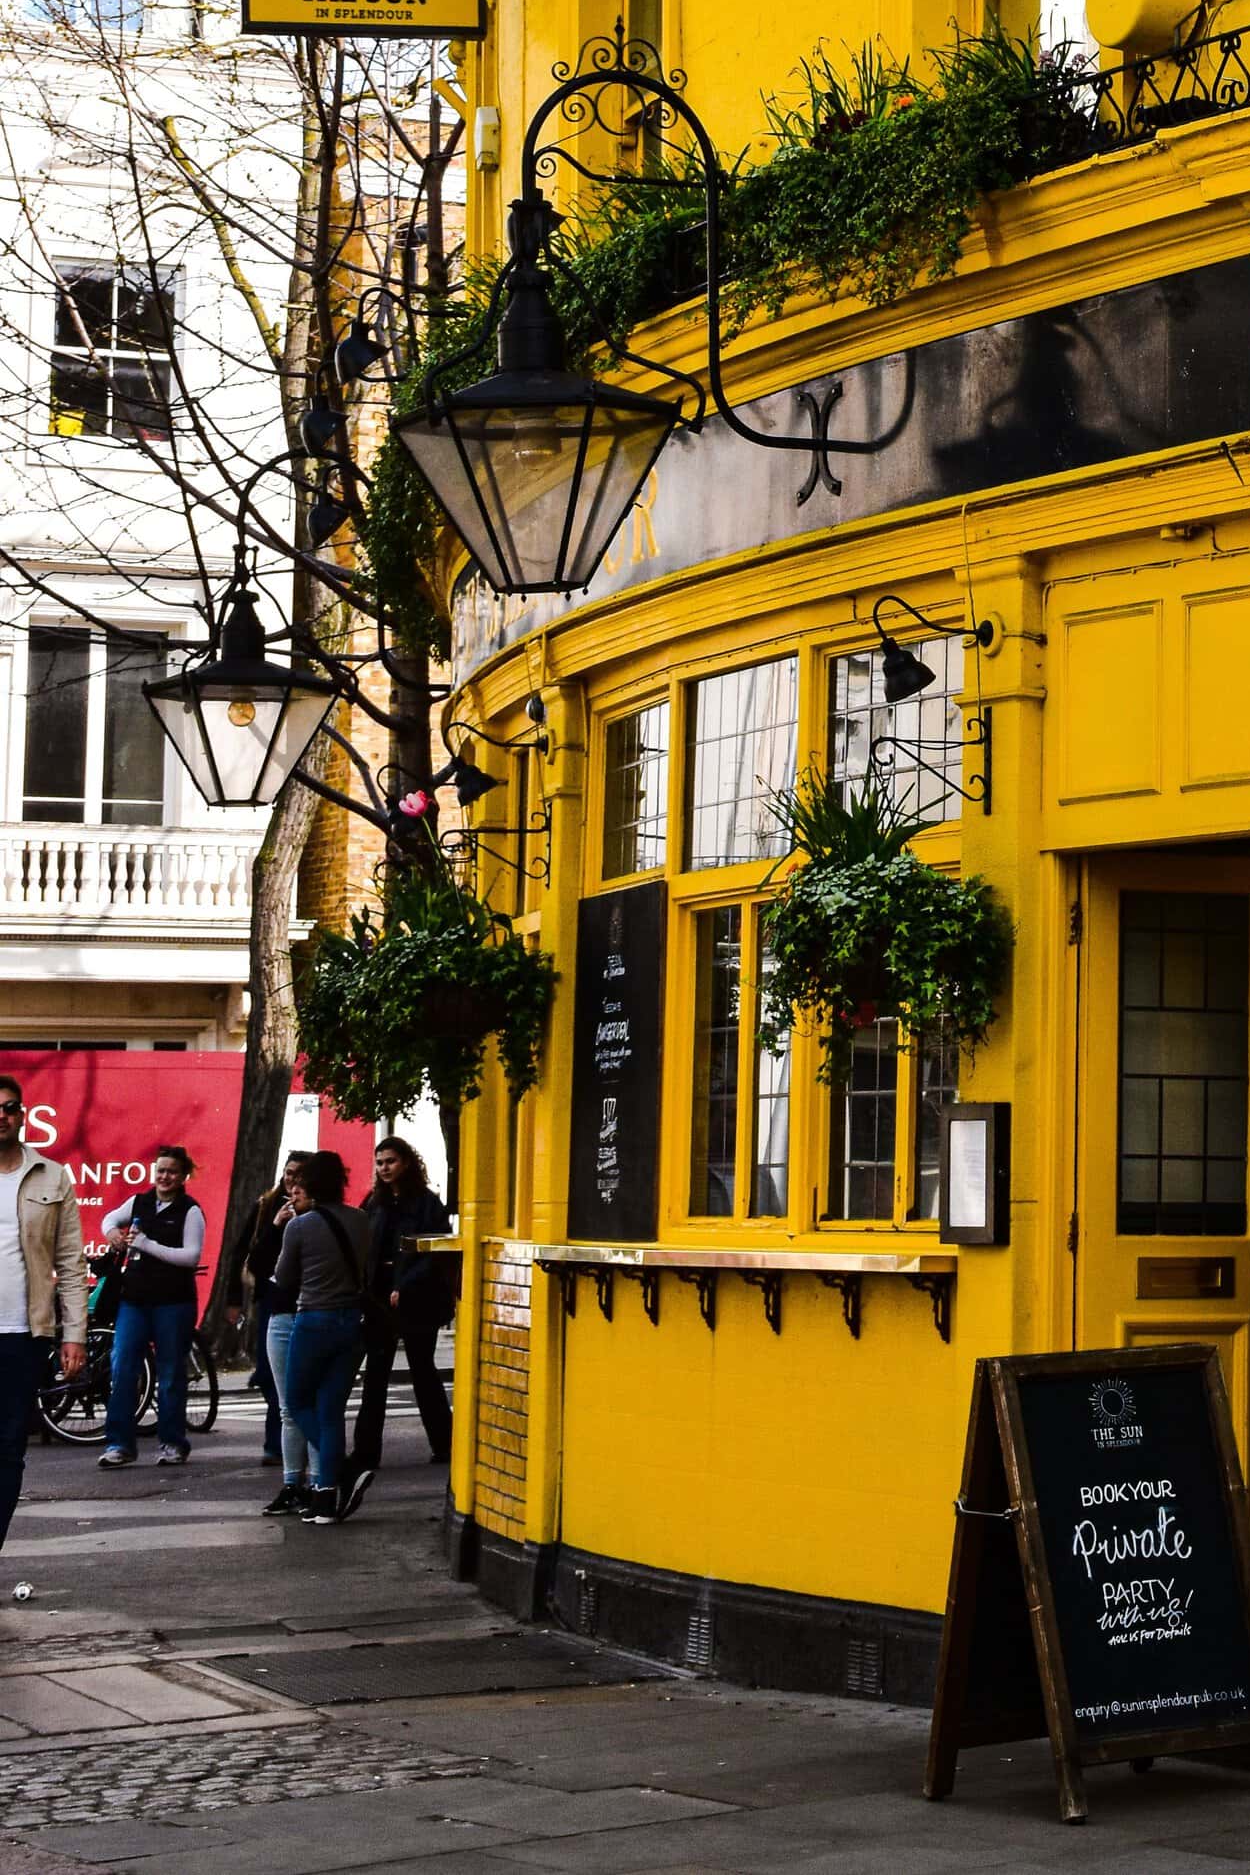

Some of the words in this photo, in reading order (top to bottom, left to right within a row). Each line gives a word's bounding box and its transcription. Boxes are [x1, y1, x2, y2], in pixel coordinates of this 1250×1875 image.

[315, 7, 329, 19] IN
[334, 8, 414, 21] SPLENDOUR
[1090, 1427, 1115, 1441] THE
[1119, 1424, 1144, 1439] SUN
[1072, 1506, 1193, 1580] Private
[1102, 1578, 1175, 1609] PARTY
[1096, 1604, 1147, 1631] with
